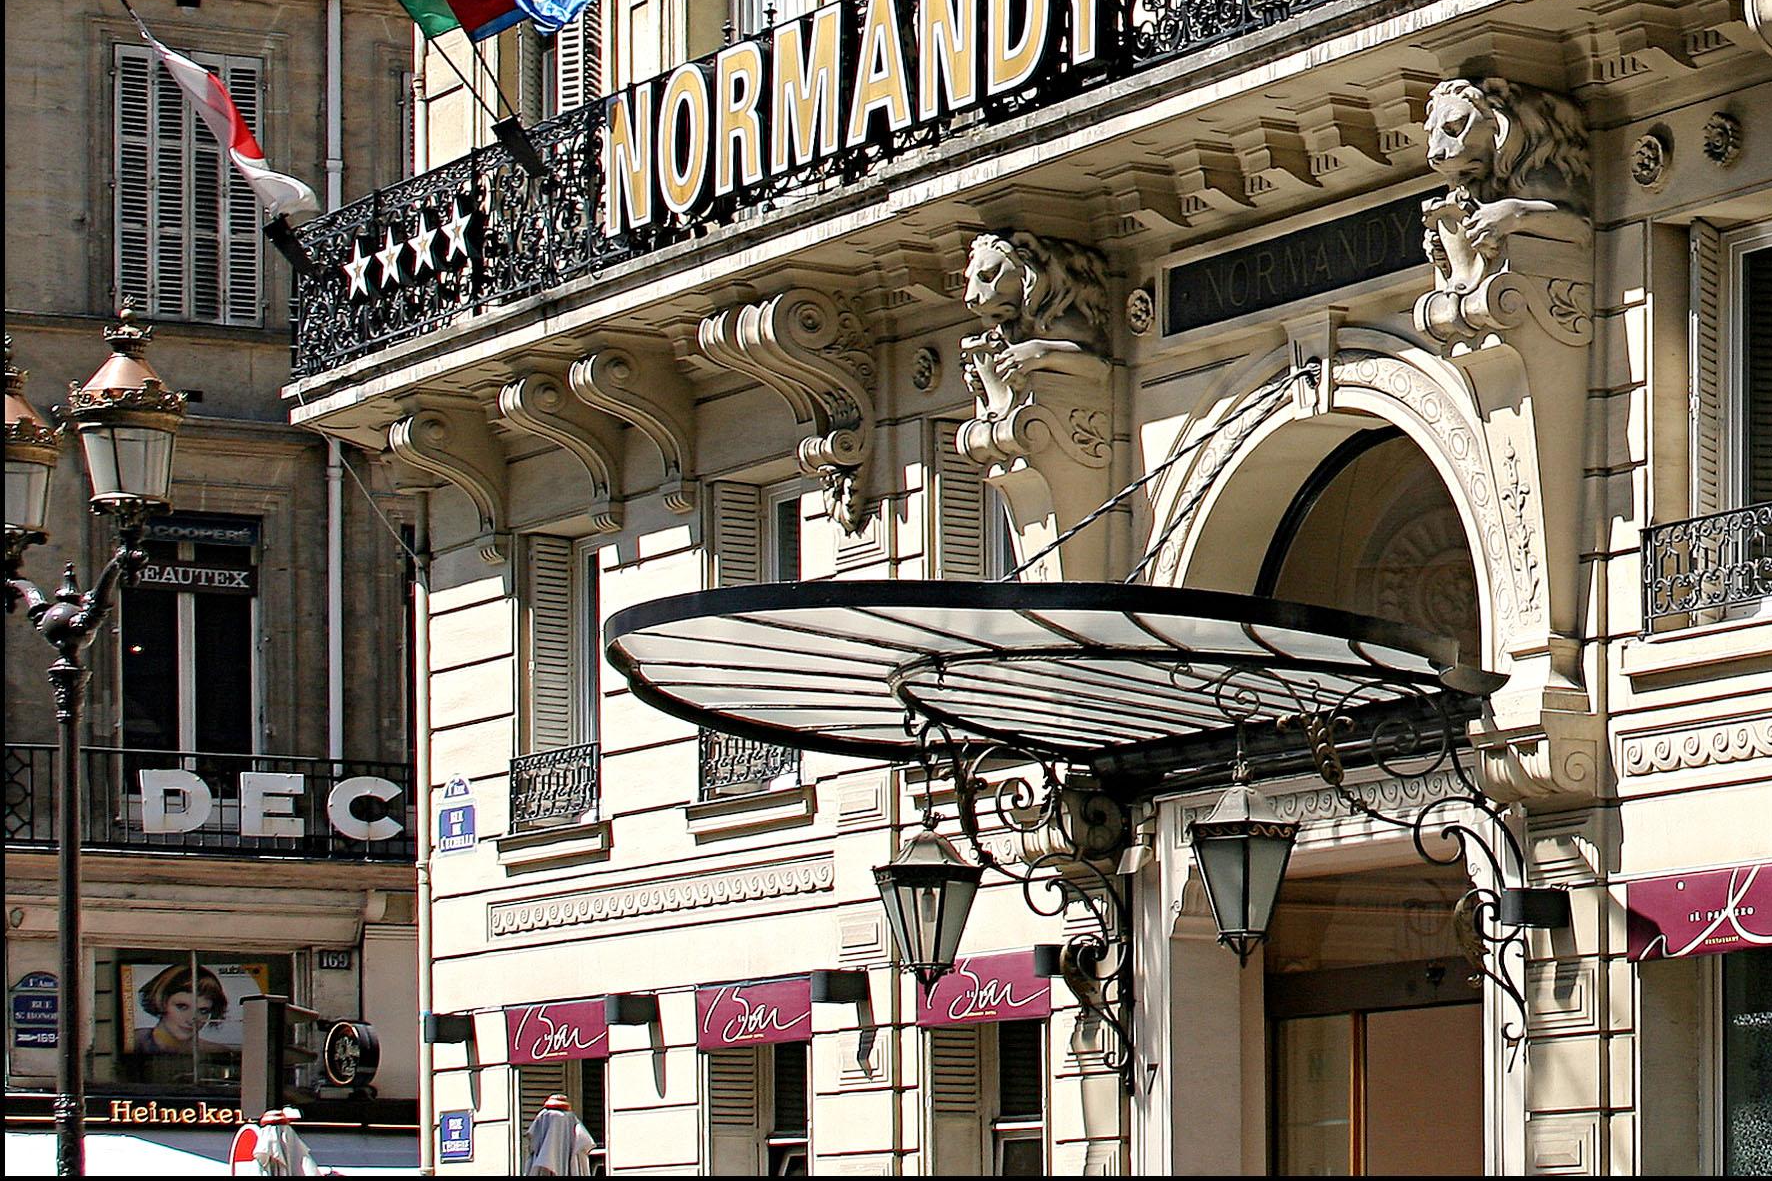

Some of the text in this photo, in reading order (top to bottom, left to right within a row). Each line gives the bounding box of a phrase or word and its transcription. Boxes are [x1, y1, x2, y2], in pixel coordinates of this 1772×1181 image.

[1203, 207, 1417, 313] NORMANDY
[141, 564, 250, 588] EAUTEX
[321, 951, 348, 968] 169
[1147, 1063, 1159, 1095] 7
